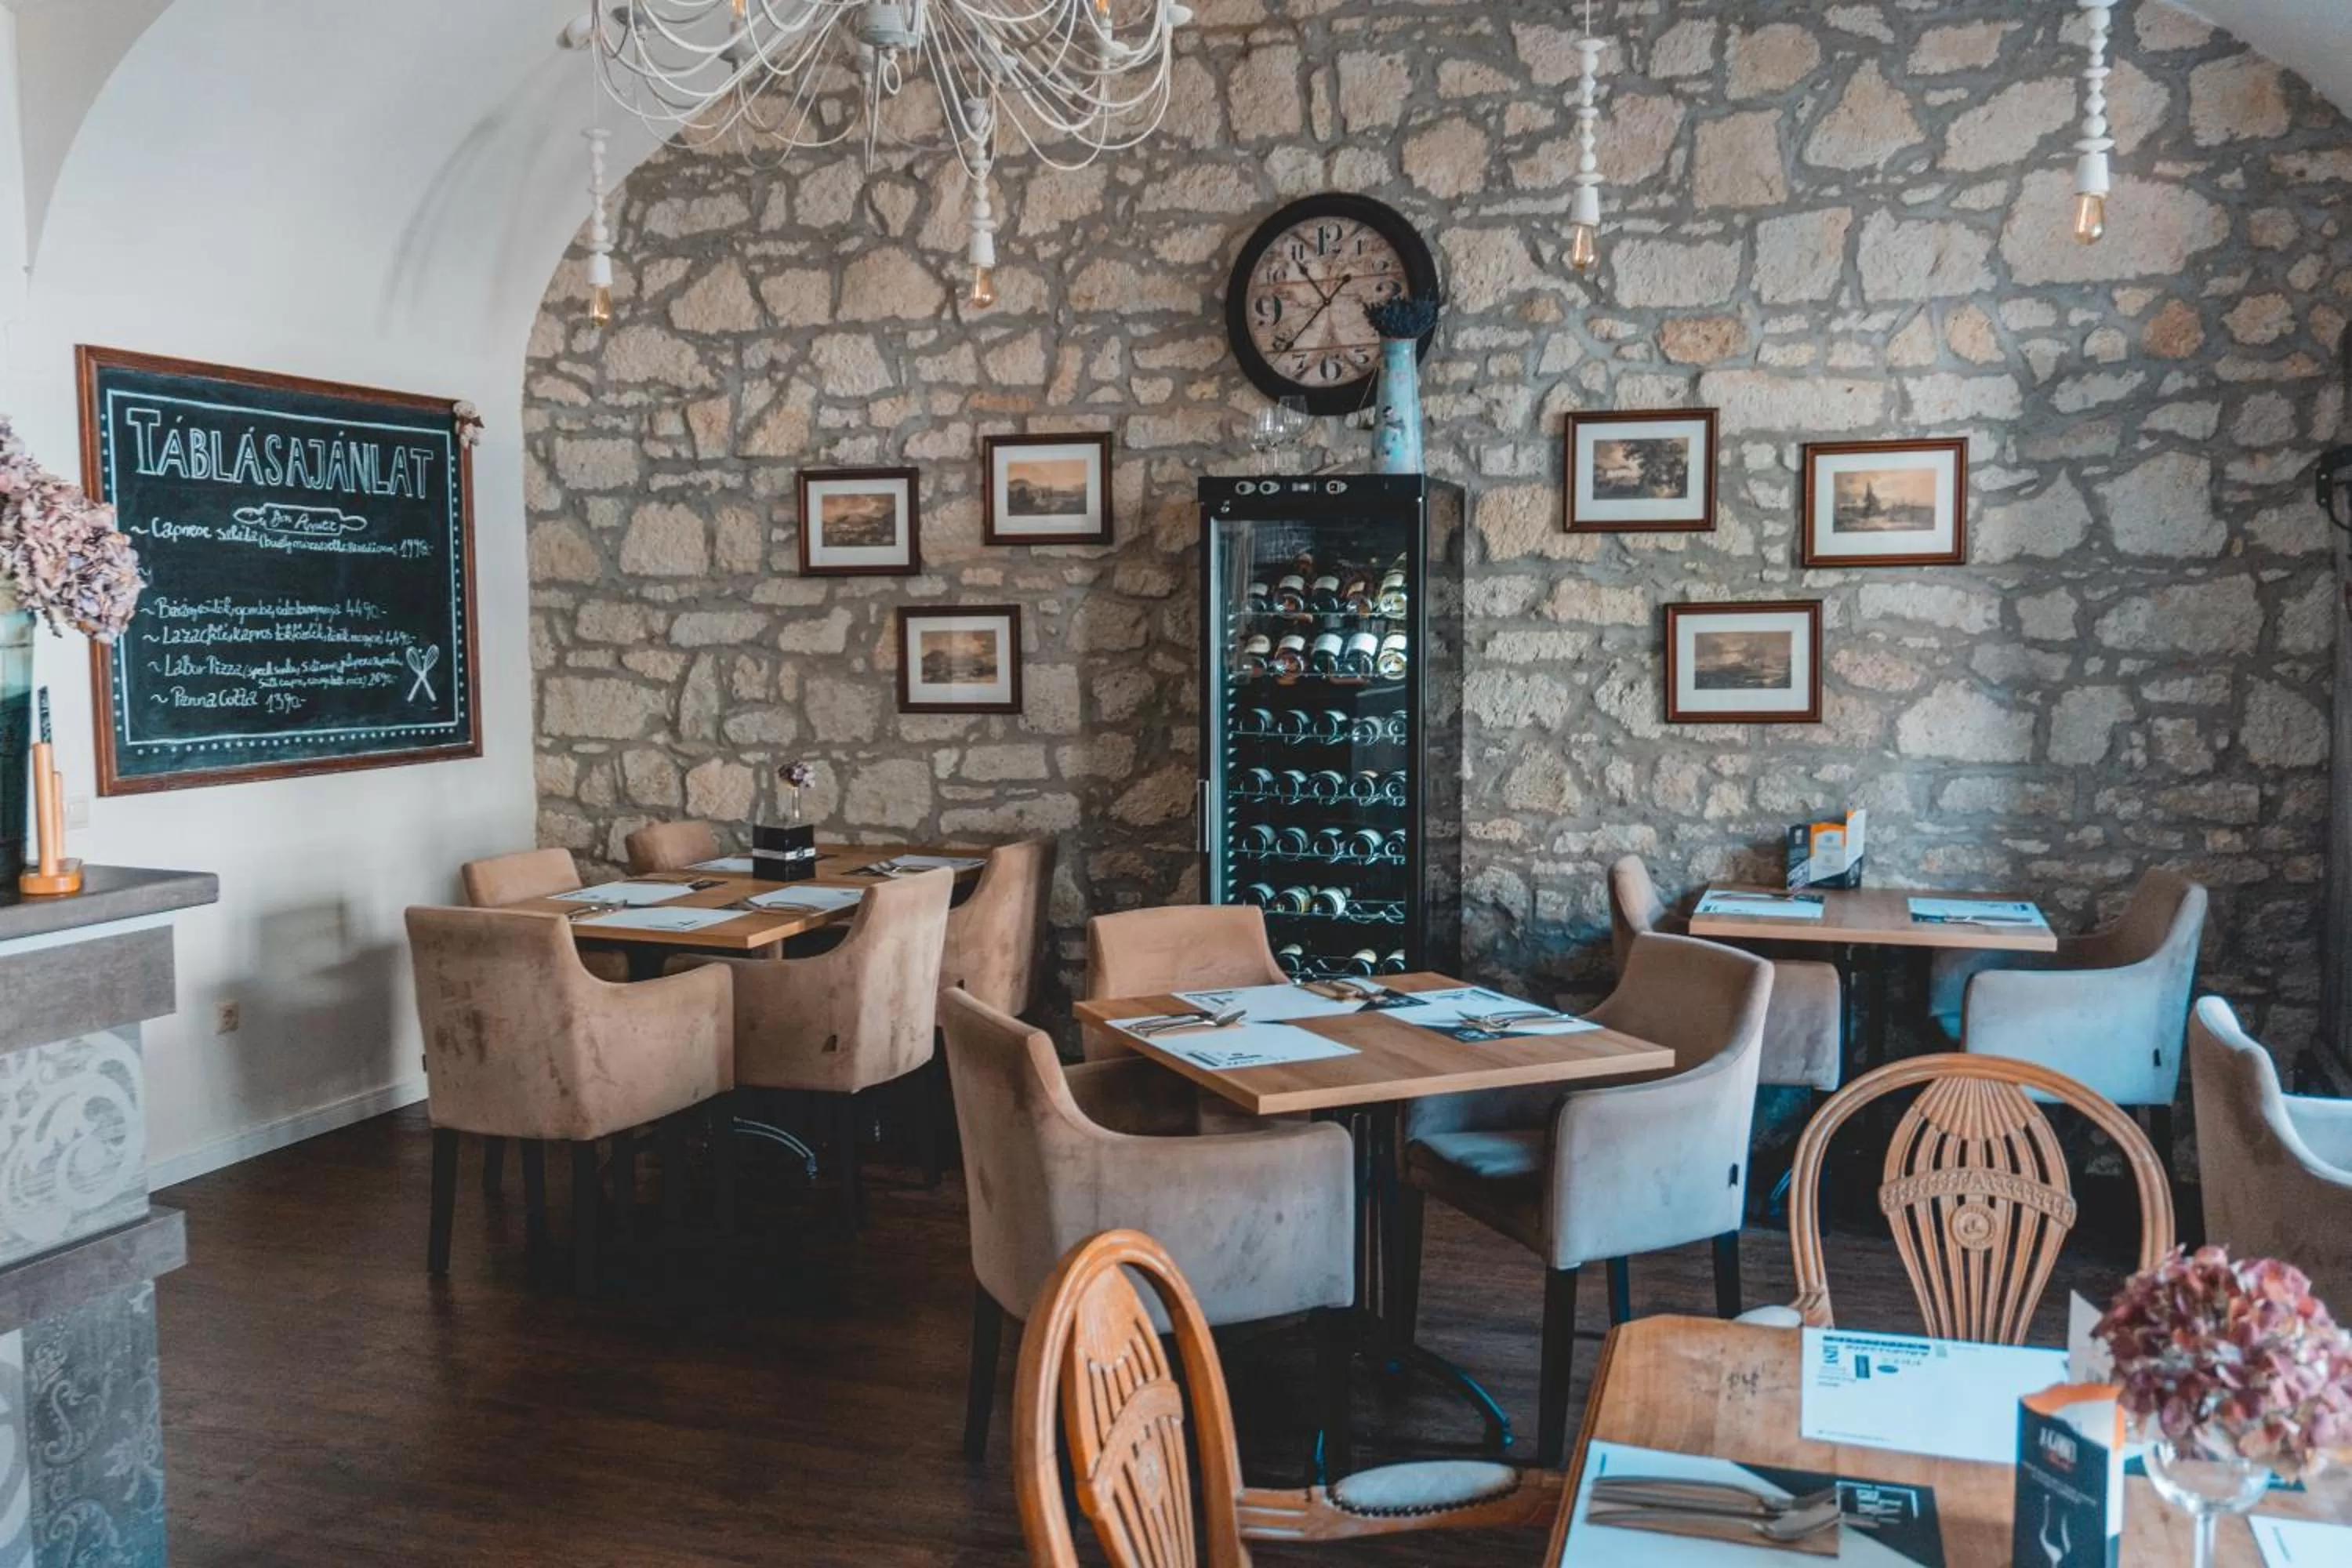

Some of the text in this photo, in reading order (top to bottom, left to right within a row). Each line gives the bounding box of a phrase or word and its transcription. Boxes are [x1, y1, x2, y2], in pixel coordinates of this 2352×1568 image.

[1291, 244, 1304, 261] 11
[1318, 224, 1343, 256] 12
[1357, 239, 1363, 256] 1
[1255, 296, 1282, 326] 9
[1320, 353, 1342, 379] 6
[126, 407, 434, 499] TÁBLÁSAJÁNLAT
